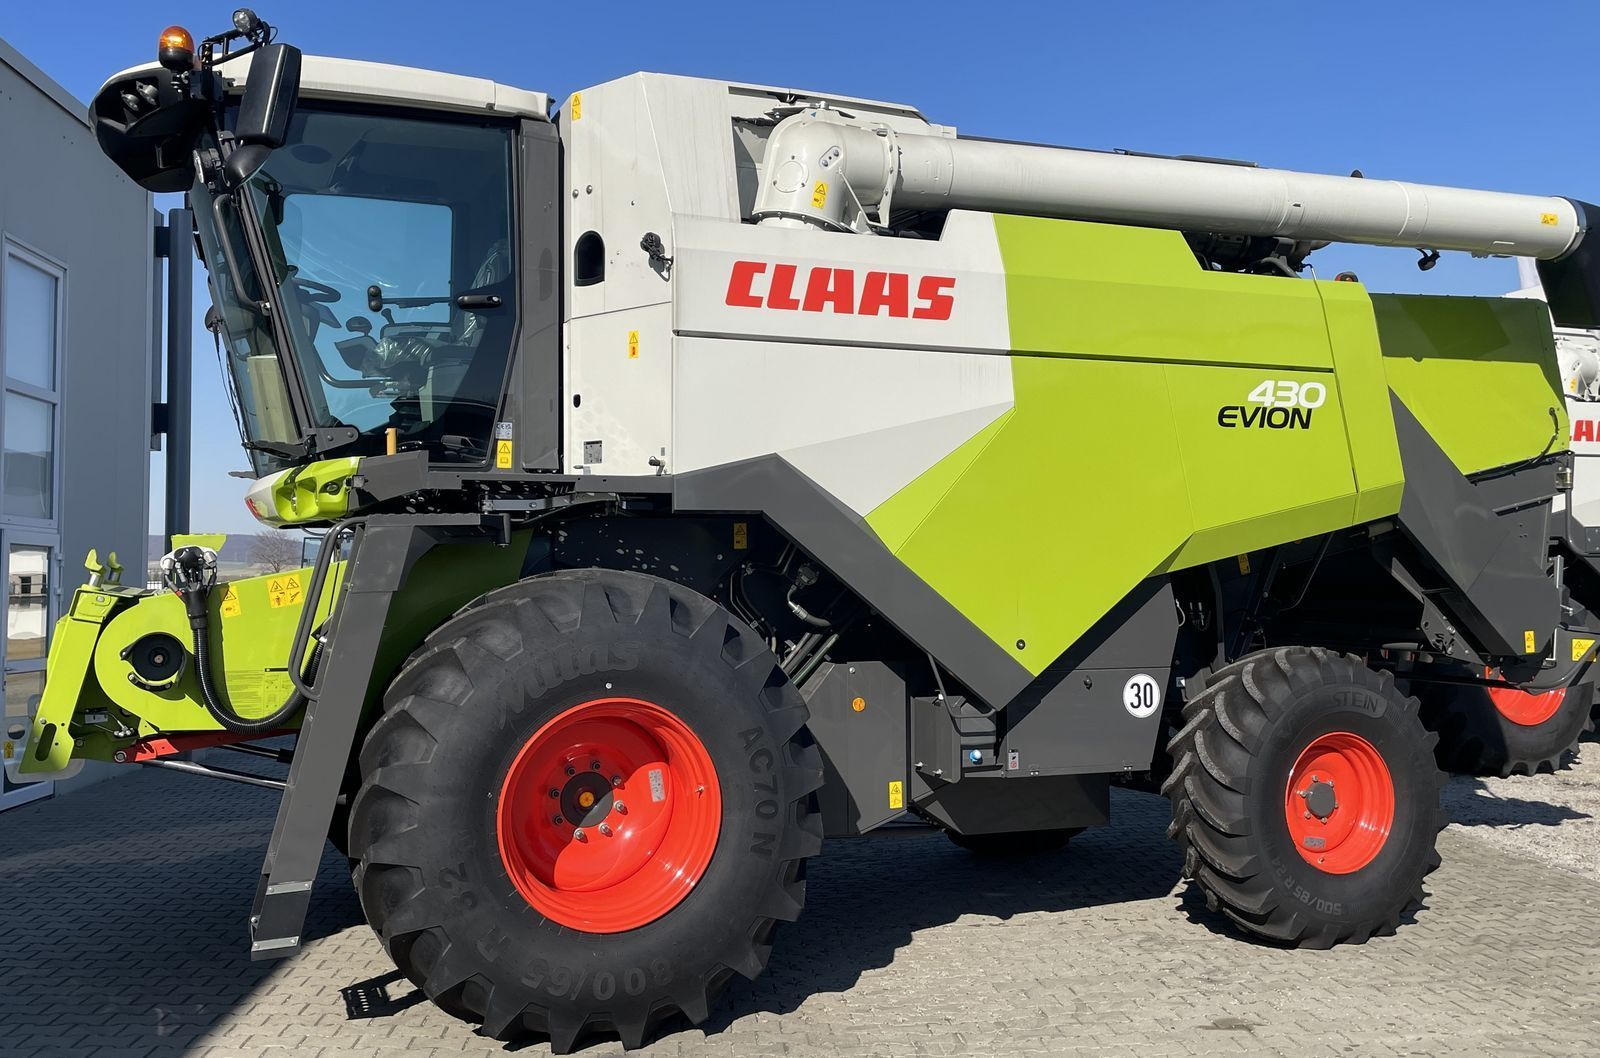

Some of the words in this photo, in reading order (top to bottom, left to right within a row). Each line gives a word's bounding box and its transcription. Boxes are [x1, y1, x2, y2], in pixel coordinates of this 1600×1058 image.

[725, 260, 957, 321] CLAAS
[1248, 380, 1327, 409] 430
[1217, 405, 1313, 430] EVION
[1129, 681, 1154, 708] 30
[737, 726, 779, 820] AC70
[750, 831, 777, 857] N
[1284, 875, 1296, 889] R
[1292, 885, 1342, 916] 500/85
[520, 957, 675, 1001] 800/65
